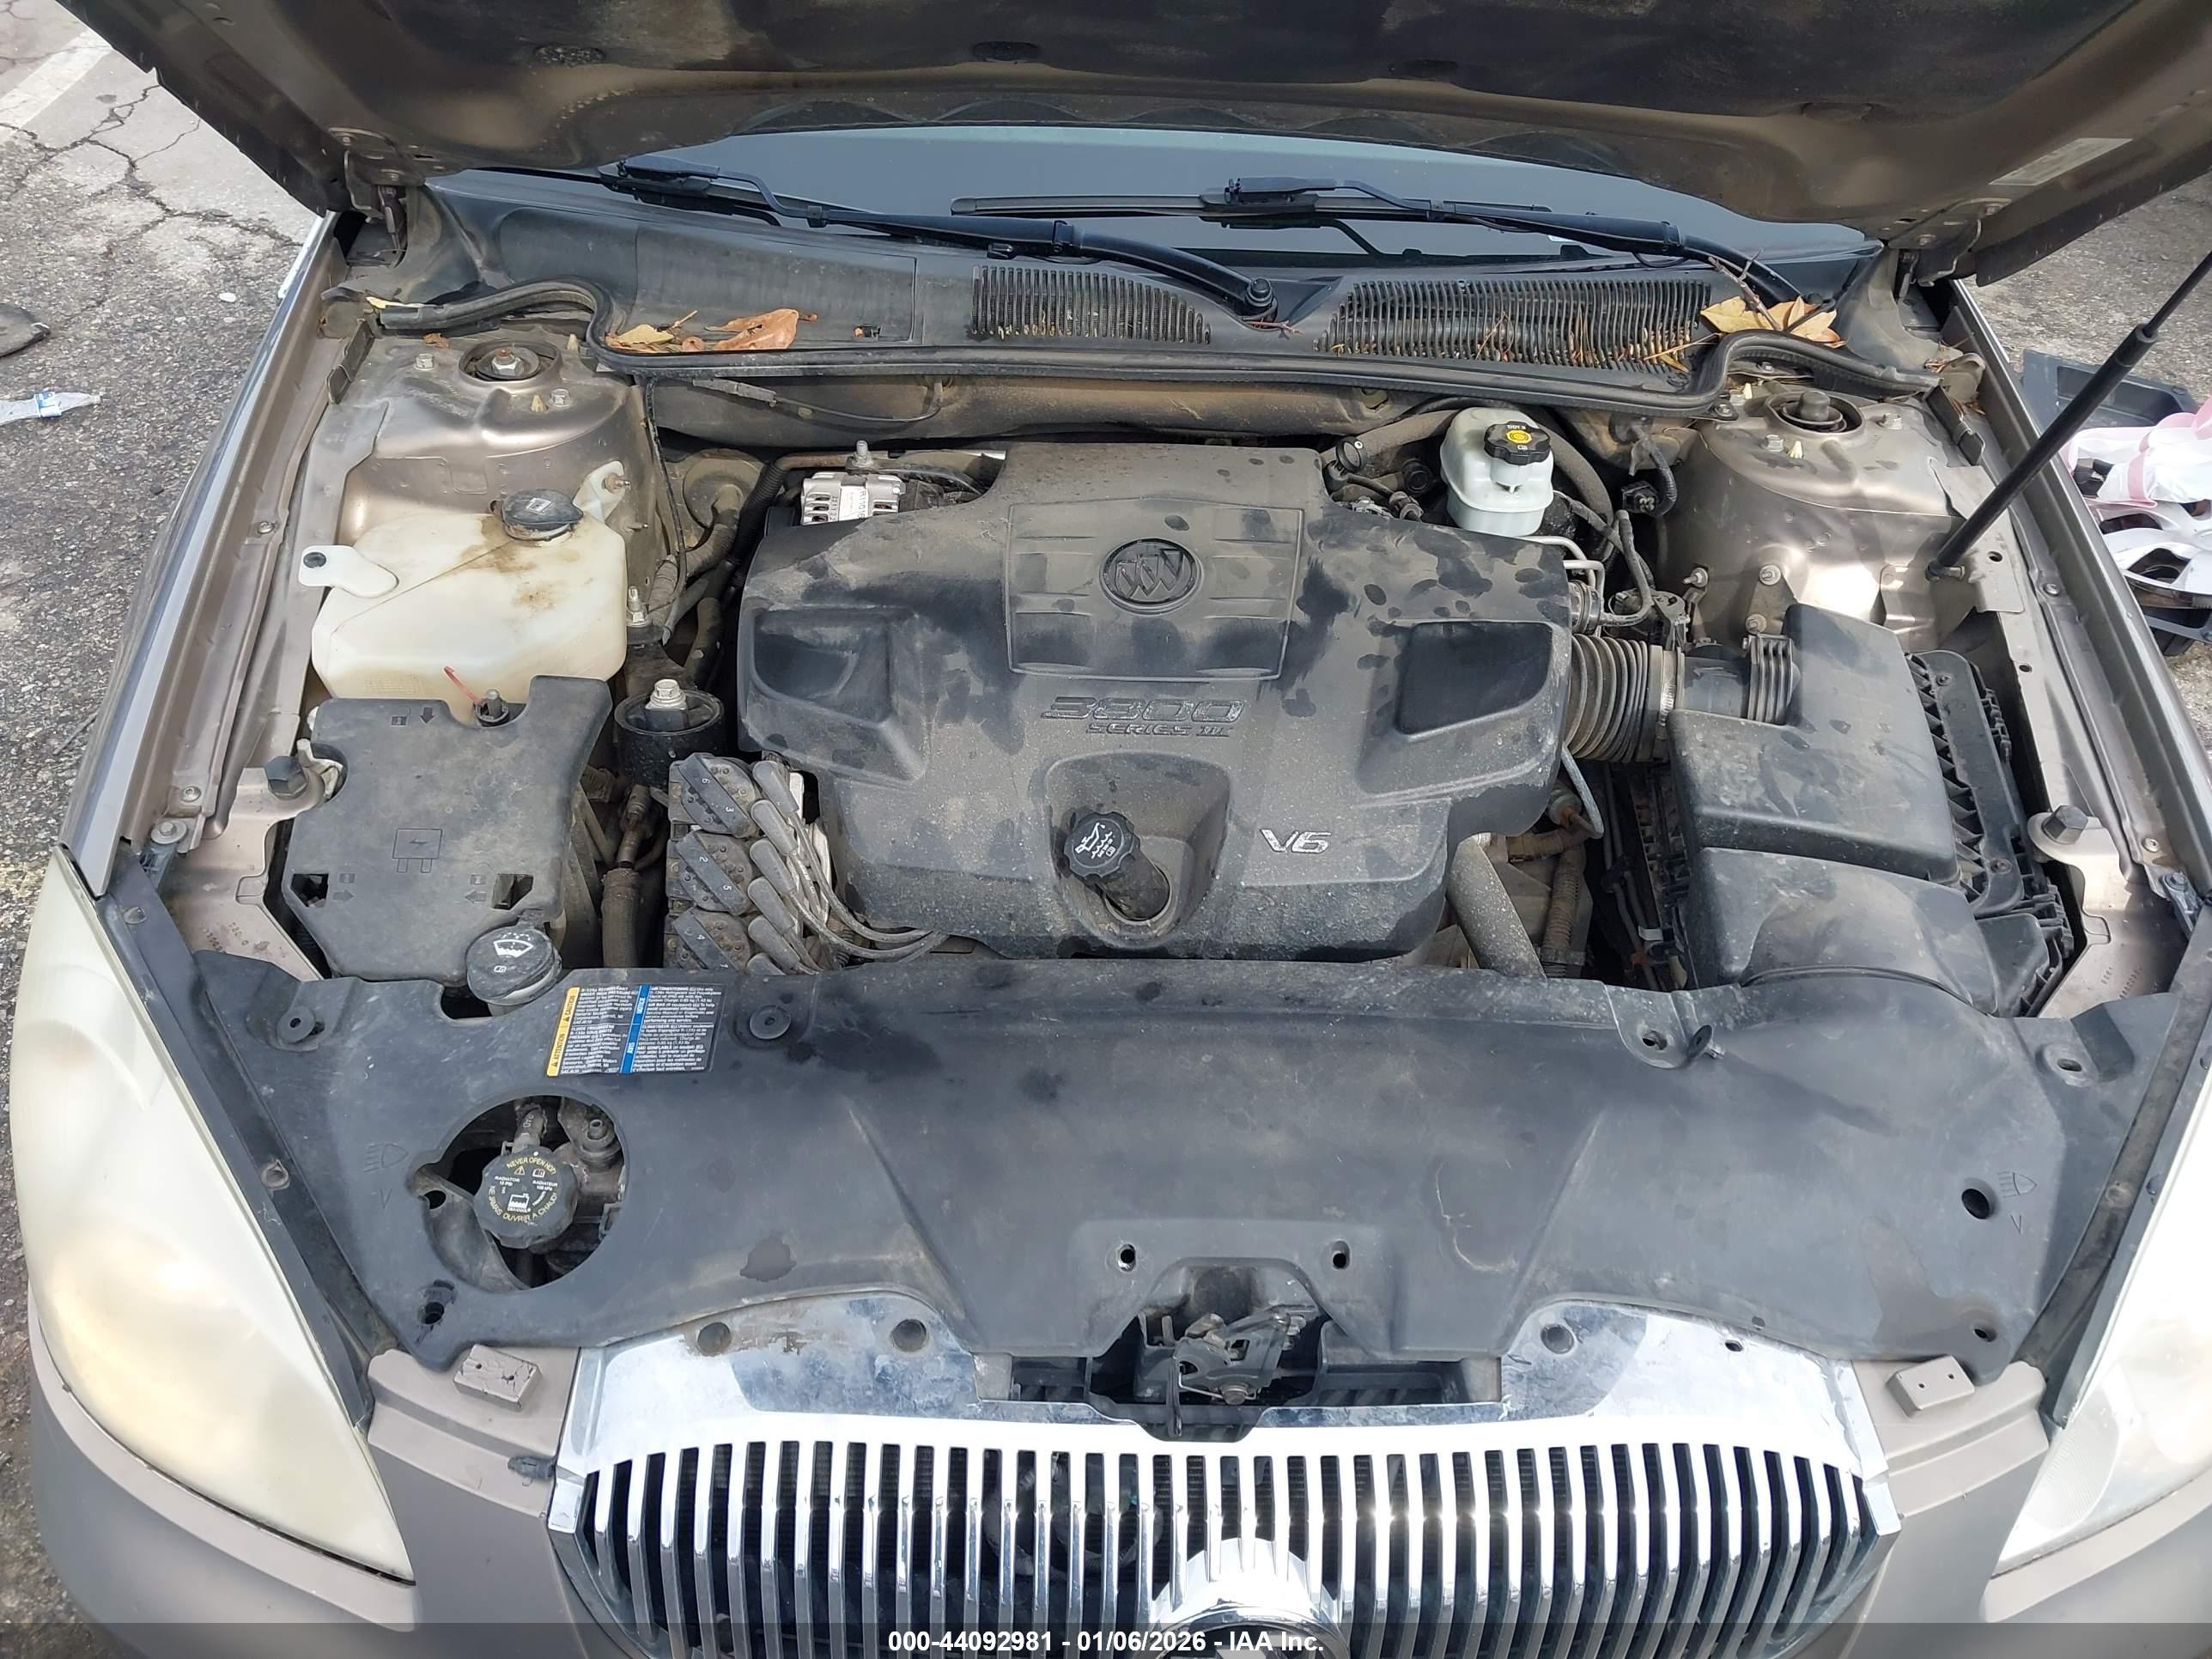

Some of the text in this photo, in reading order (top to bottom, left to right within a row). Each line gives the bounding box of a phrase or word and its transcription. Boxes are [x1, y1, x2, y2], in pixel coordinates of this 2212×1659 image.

[1041, 696, 1244, 723] 3800
[1086, 723, 1193, 736] SERIES
[1260, 828, 1332, 854] V6
[507, 1157, 528, 1169] NEVER
[529, 1157, 546, 1166] OPEN
[502, 1212, 531, 1223] OUVRIR
